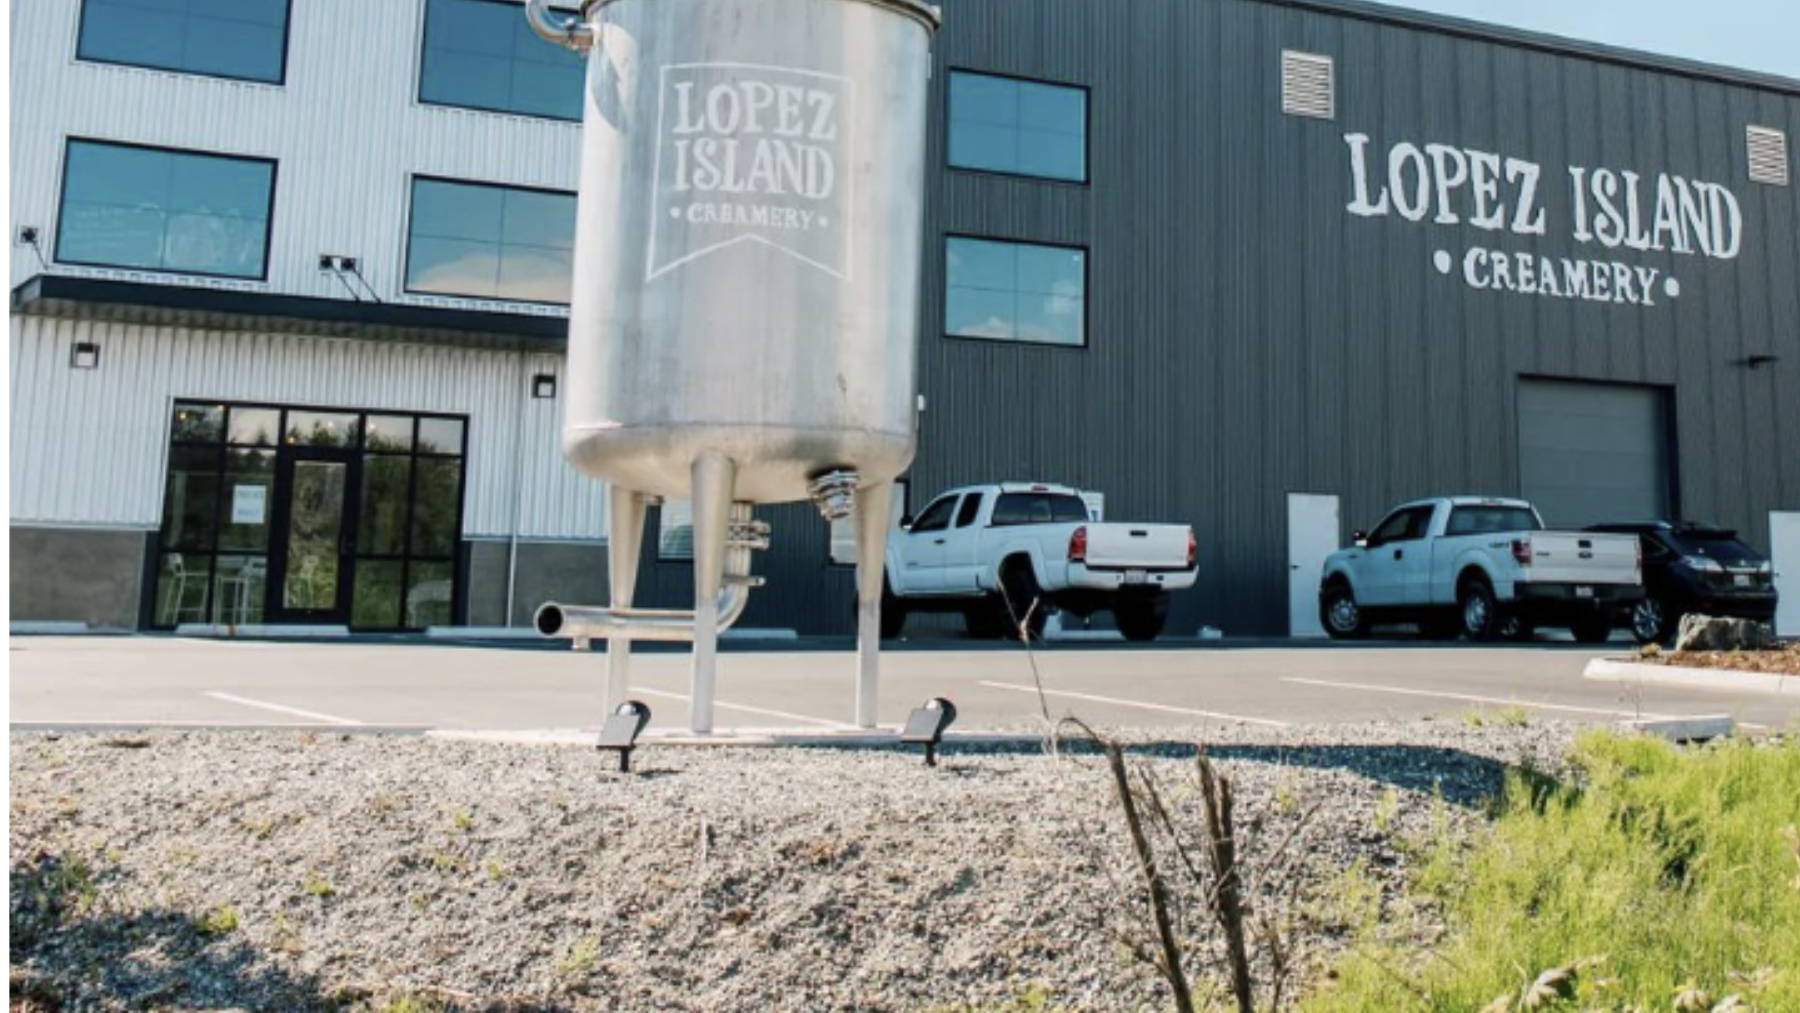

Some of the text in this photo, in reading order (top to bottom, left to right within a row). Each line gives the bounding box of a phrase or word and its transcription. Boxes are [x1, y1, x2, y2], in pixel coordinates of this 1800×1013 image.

[673, 80, 837, 141] LOPEZ
[673, 138, 835, 200] ISLAND
[1343, 132, 1743, 259] LOPEZ ISLAND
[687, 202, 815, 231] CREAMERY
[1462, 246, 1660, 306] CREAMERY
